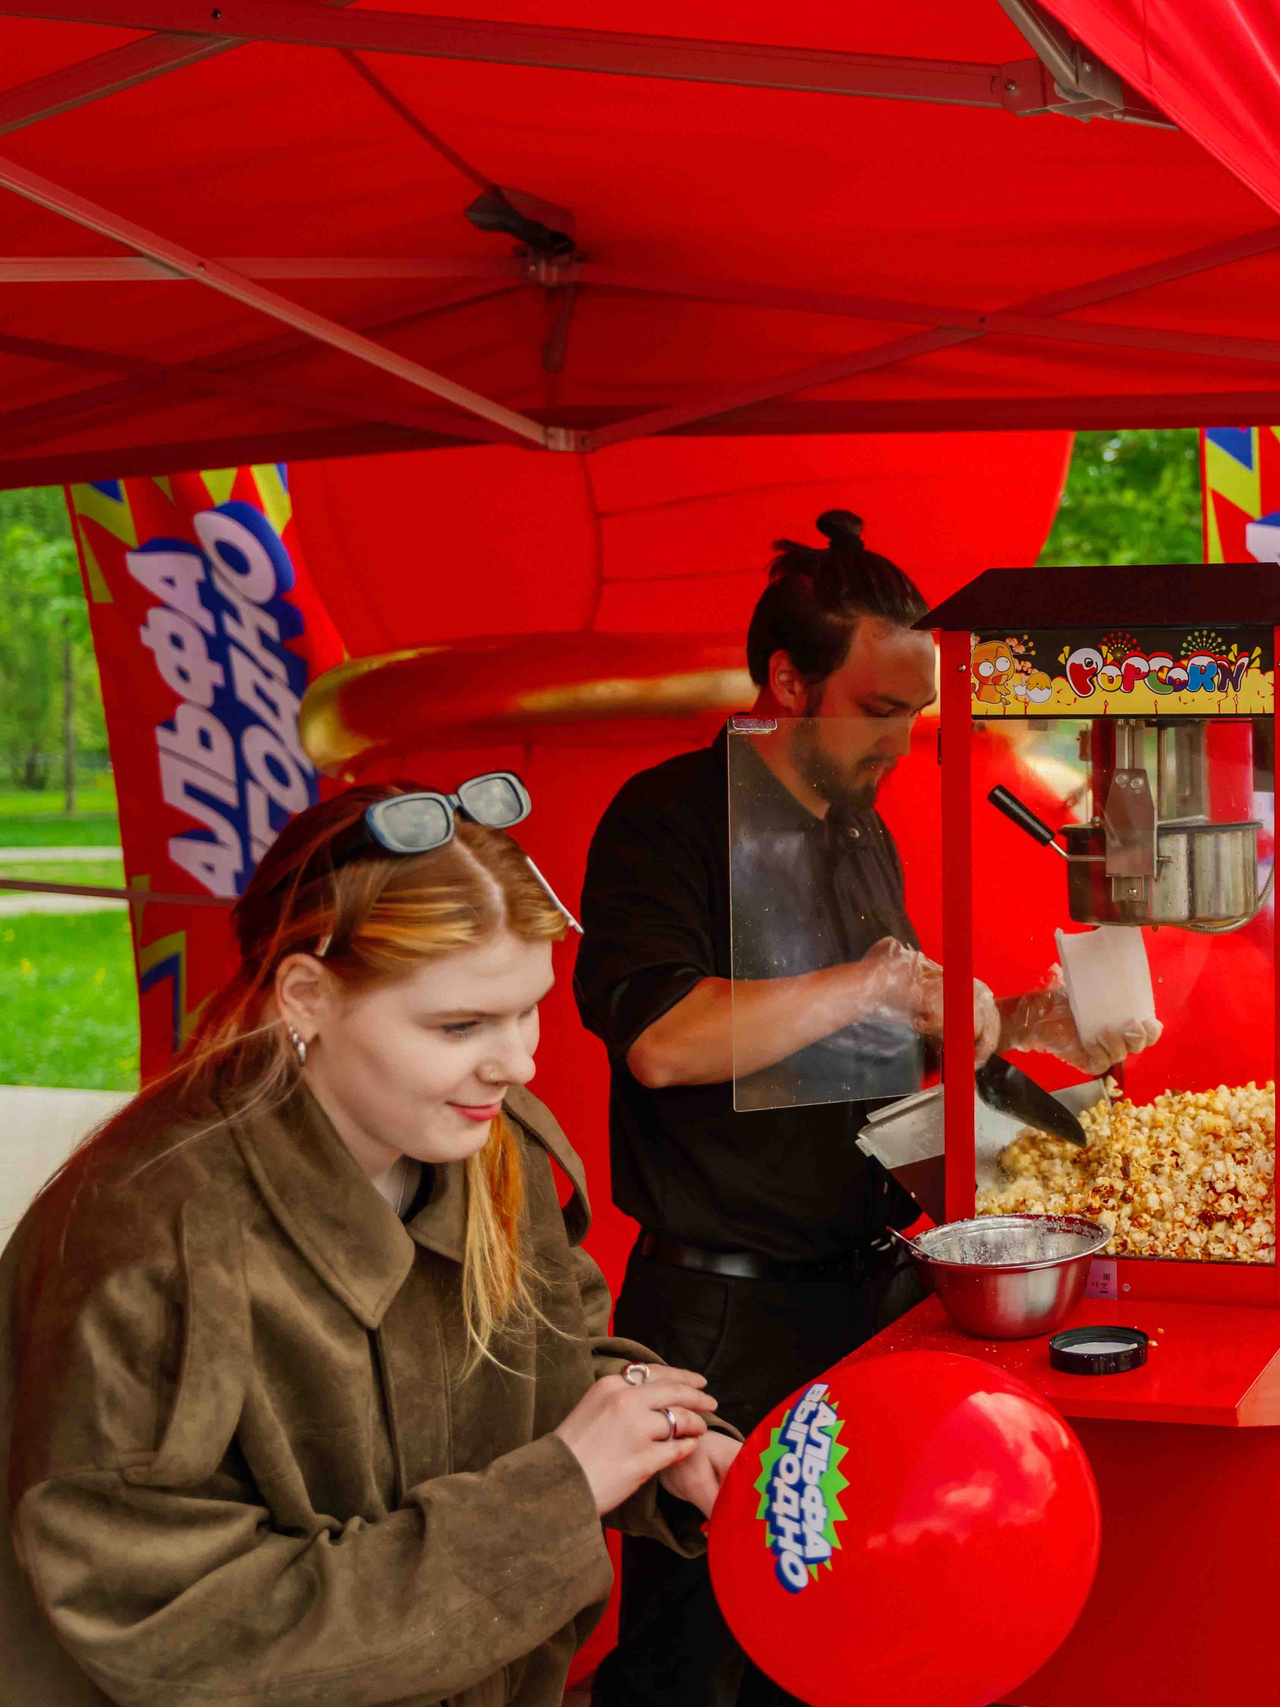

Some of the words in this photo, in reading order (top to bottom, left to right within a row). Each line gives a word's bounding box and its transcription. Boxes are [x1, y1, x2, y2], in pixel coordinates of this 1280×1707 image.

[126, 550, 245, 898] АЛЬФА
[193, 510, 313, 866] ГОДНО
[772, 1383, 829, 1589] ВЫГОДНО
[801, 1401, 839, 1559] АЛЬФА
